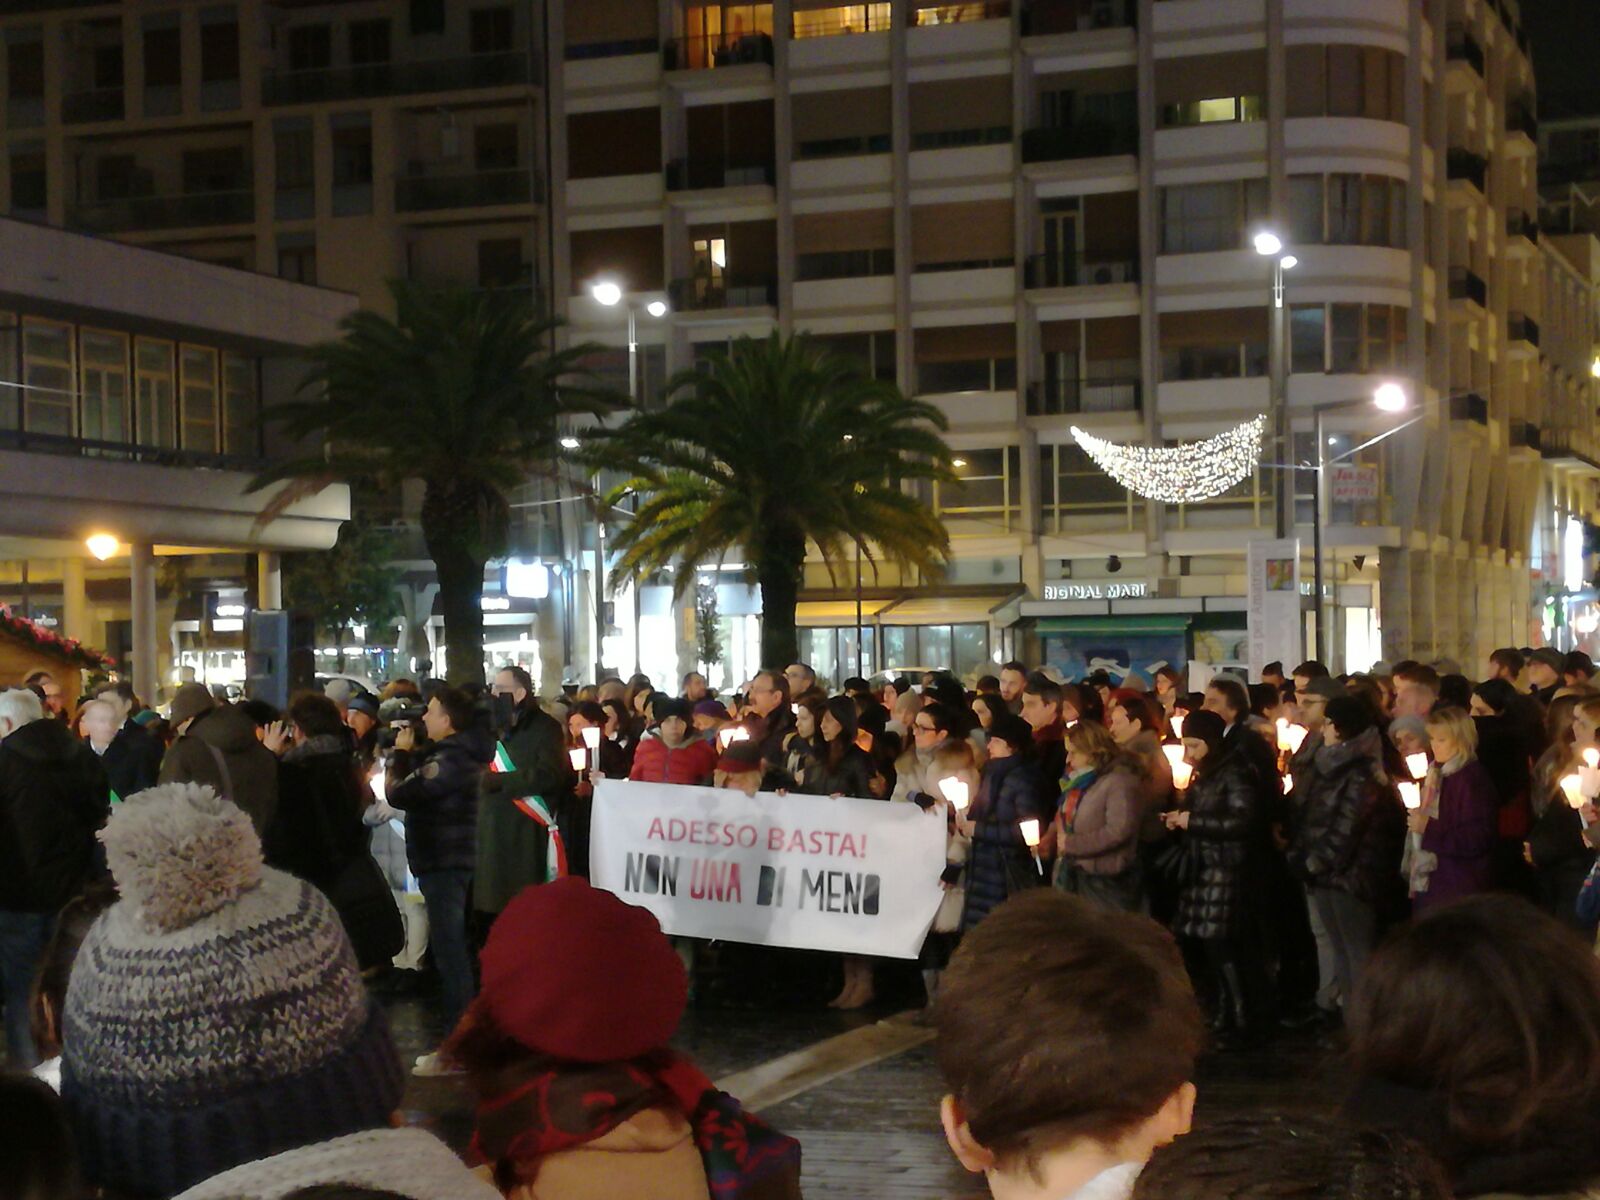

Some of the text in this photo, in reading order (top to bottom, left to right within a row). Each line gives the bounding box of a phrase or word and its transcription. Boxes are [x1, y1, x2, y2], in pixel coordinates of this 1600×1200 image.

[646, 817, 867, 859] ADESSO BASTA!
[624, 851, 881, 916] NON UNA DI MENO
